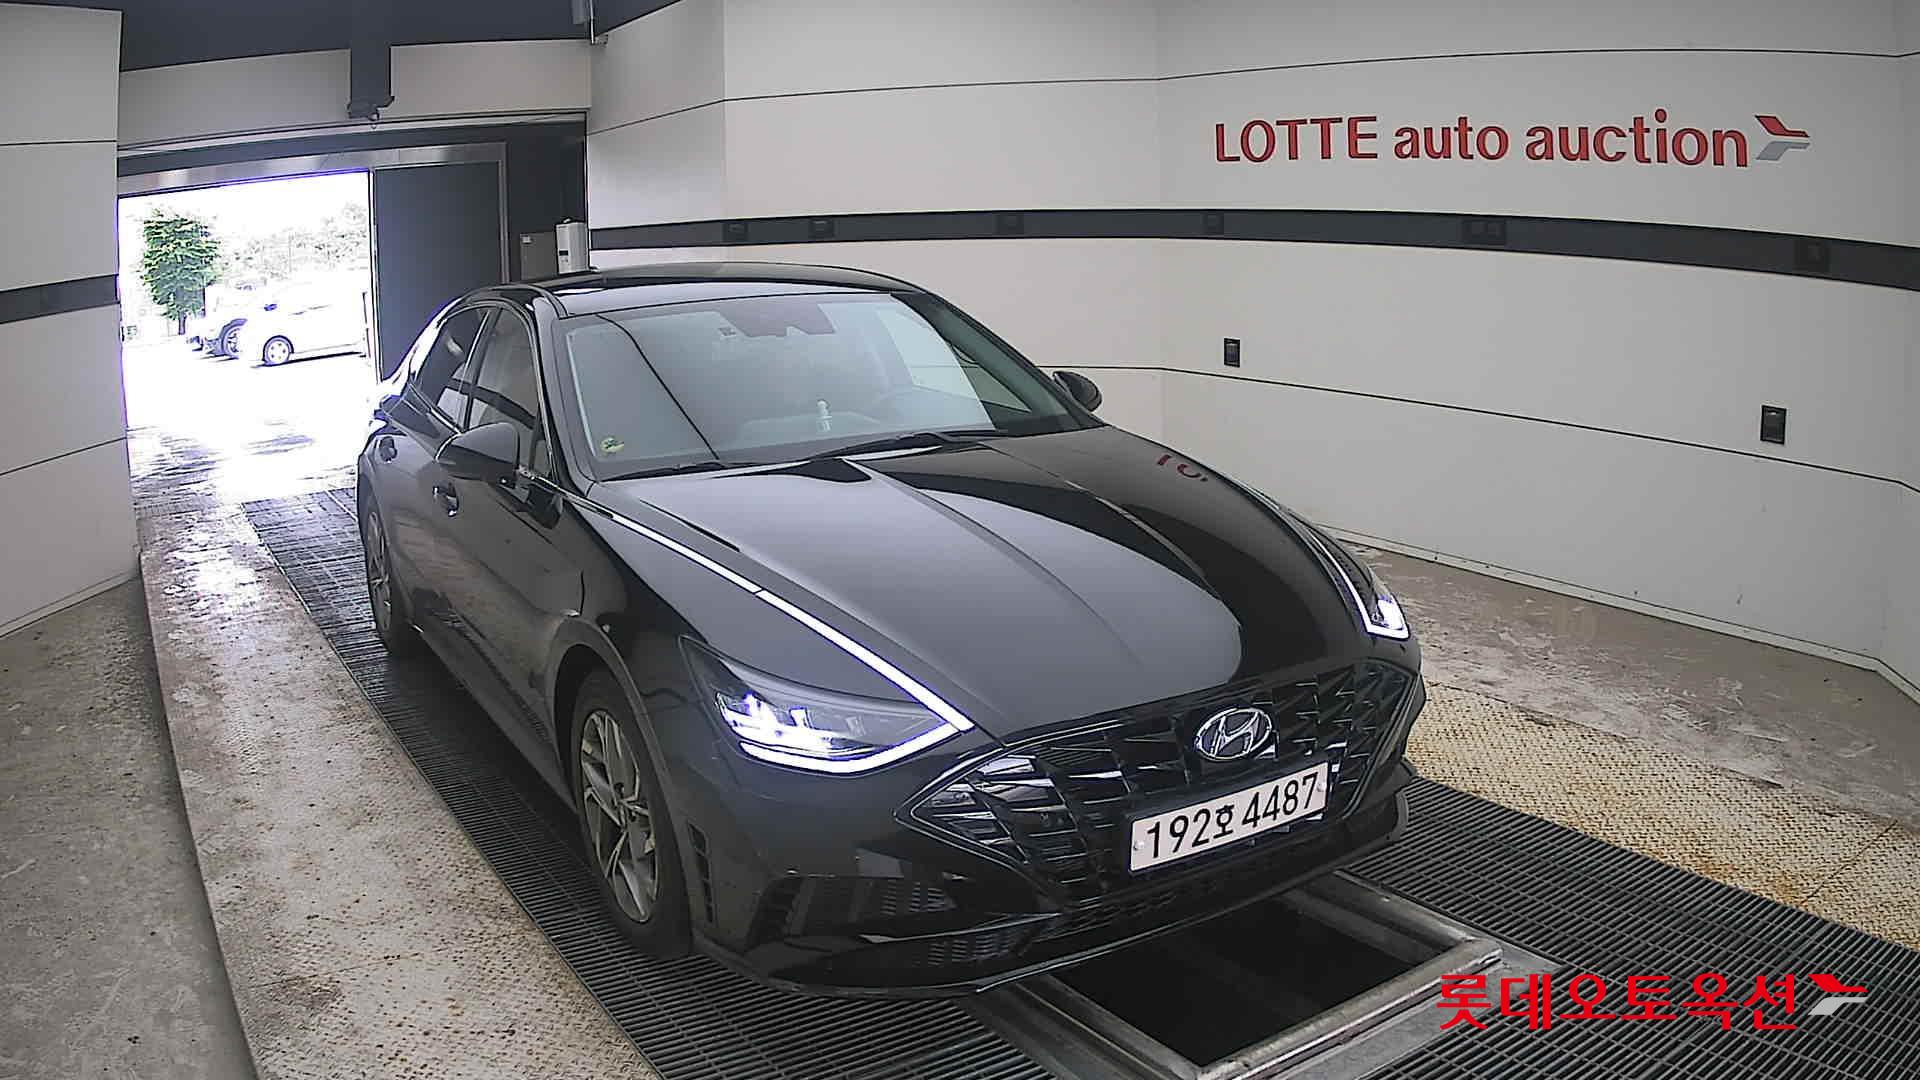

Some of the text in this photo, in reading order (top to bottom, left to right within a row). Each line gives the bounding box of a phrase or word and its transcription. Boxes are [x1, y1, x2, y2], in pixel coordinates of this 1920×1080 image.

[1214, 108, 1749, 168] LOTTE auto auction
[1146, 771, 1319, 859] 192호 4487
